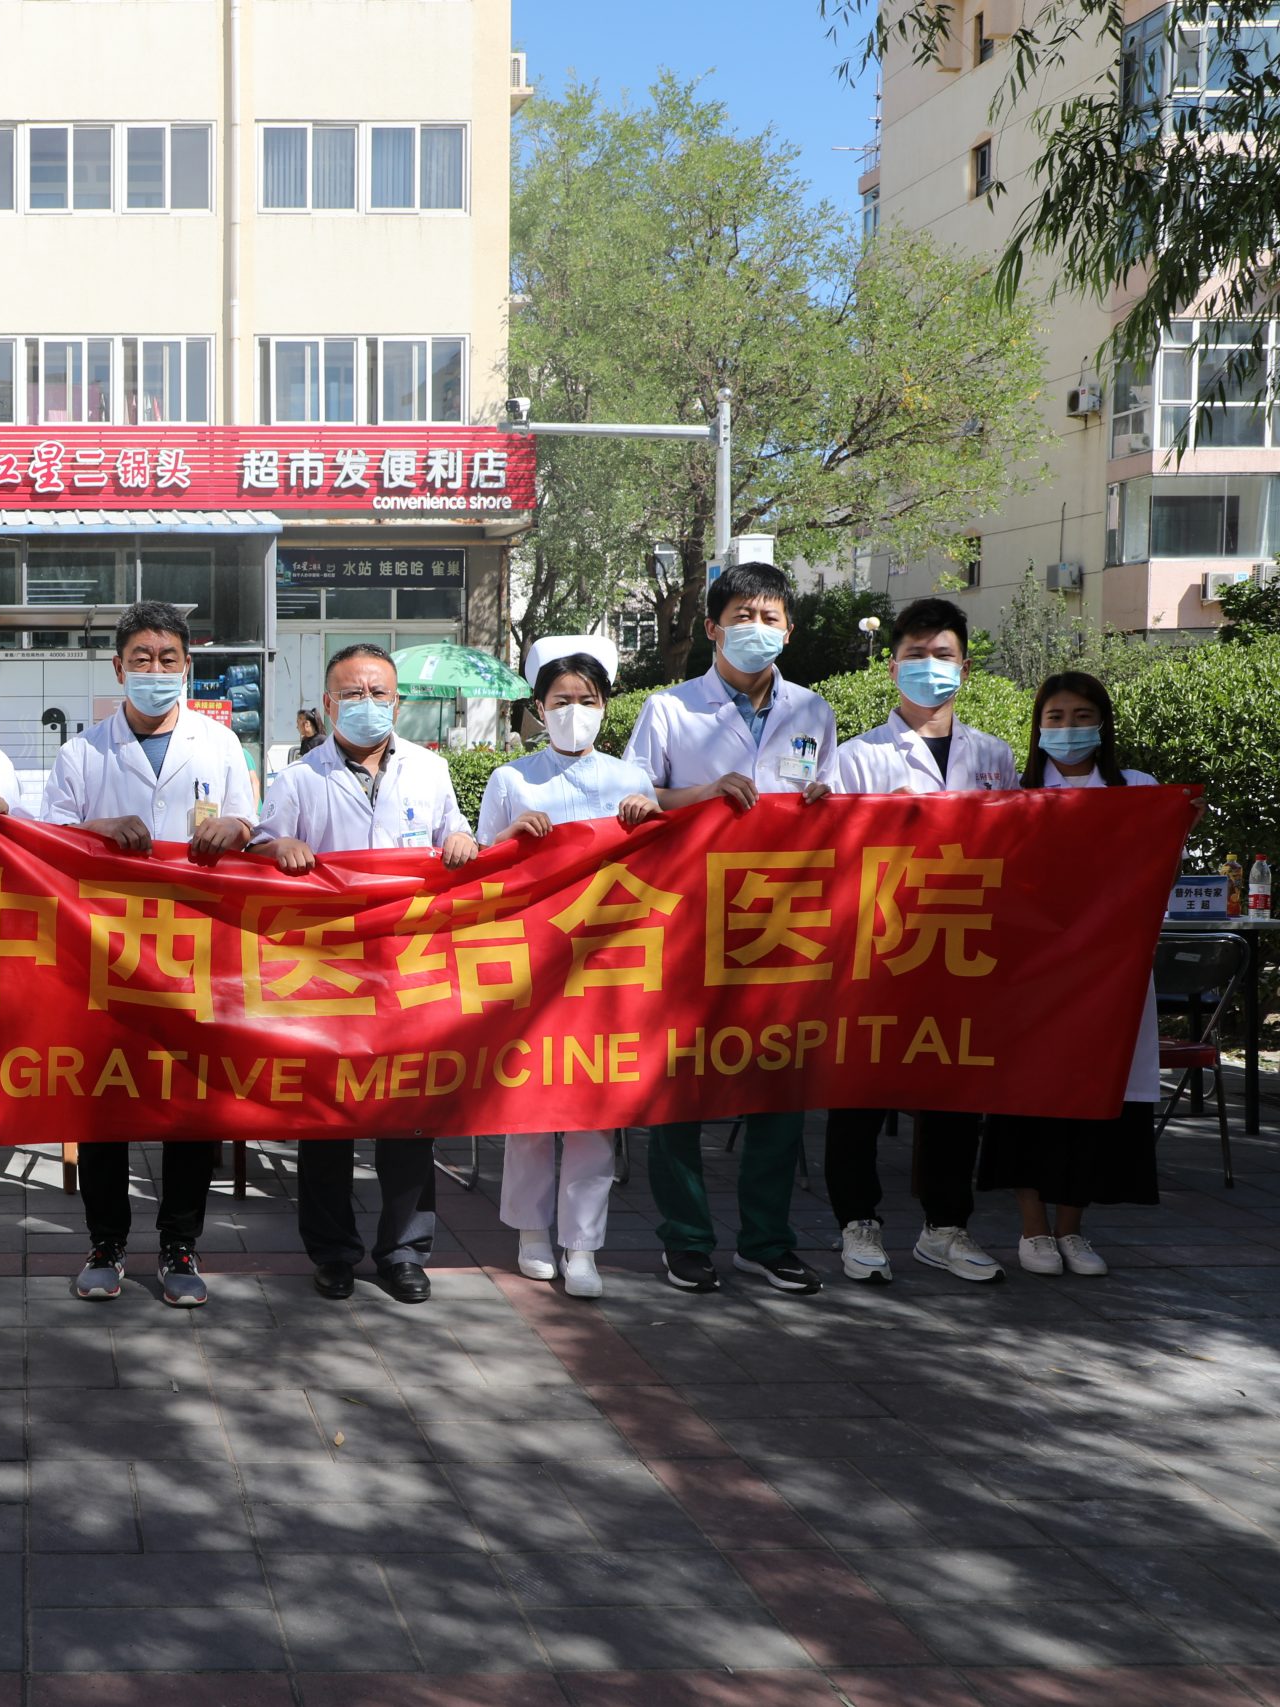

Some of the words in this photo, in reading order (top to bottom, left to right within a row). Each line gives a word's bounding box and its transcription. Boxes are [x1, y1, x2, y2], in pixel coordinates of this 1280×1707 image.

[242, 448, 508, 489] 超市发便利店
[373, 493, 466, 509] convenience
[469, 493, 512, 509] shore
[343, 561, 372, 576] 水站
[379, 561, 424, 576] 娃哈哈
[432, 561, 460, 576] 雀巢
[1175, 888, 1223, 898] 普外科专家
[334, 1032, 641, 1103] MEDICINE
[667, 1015, 995, 1078] HOSPITAL
